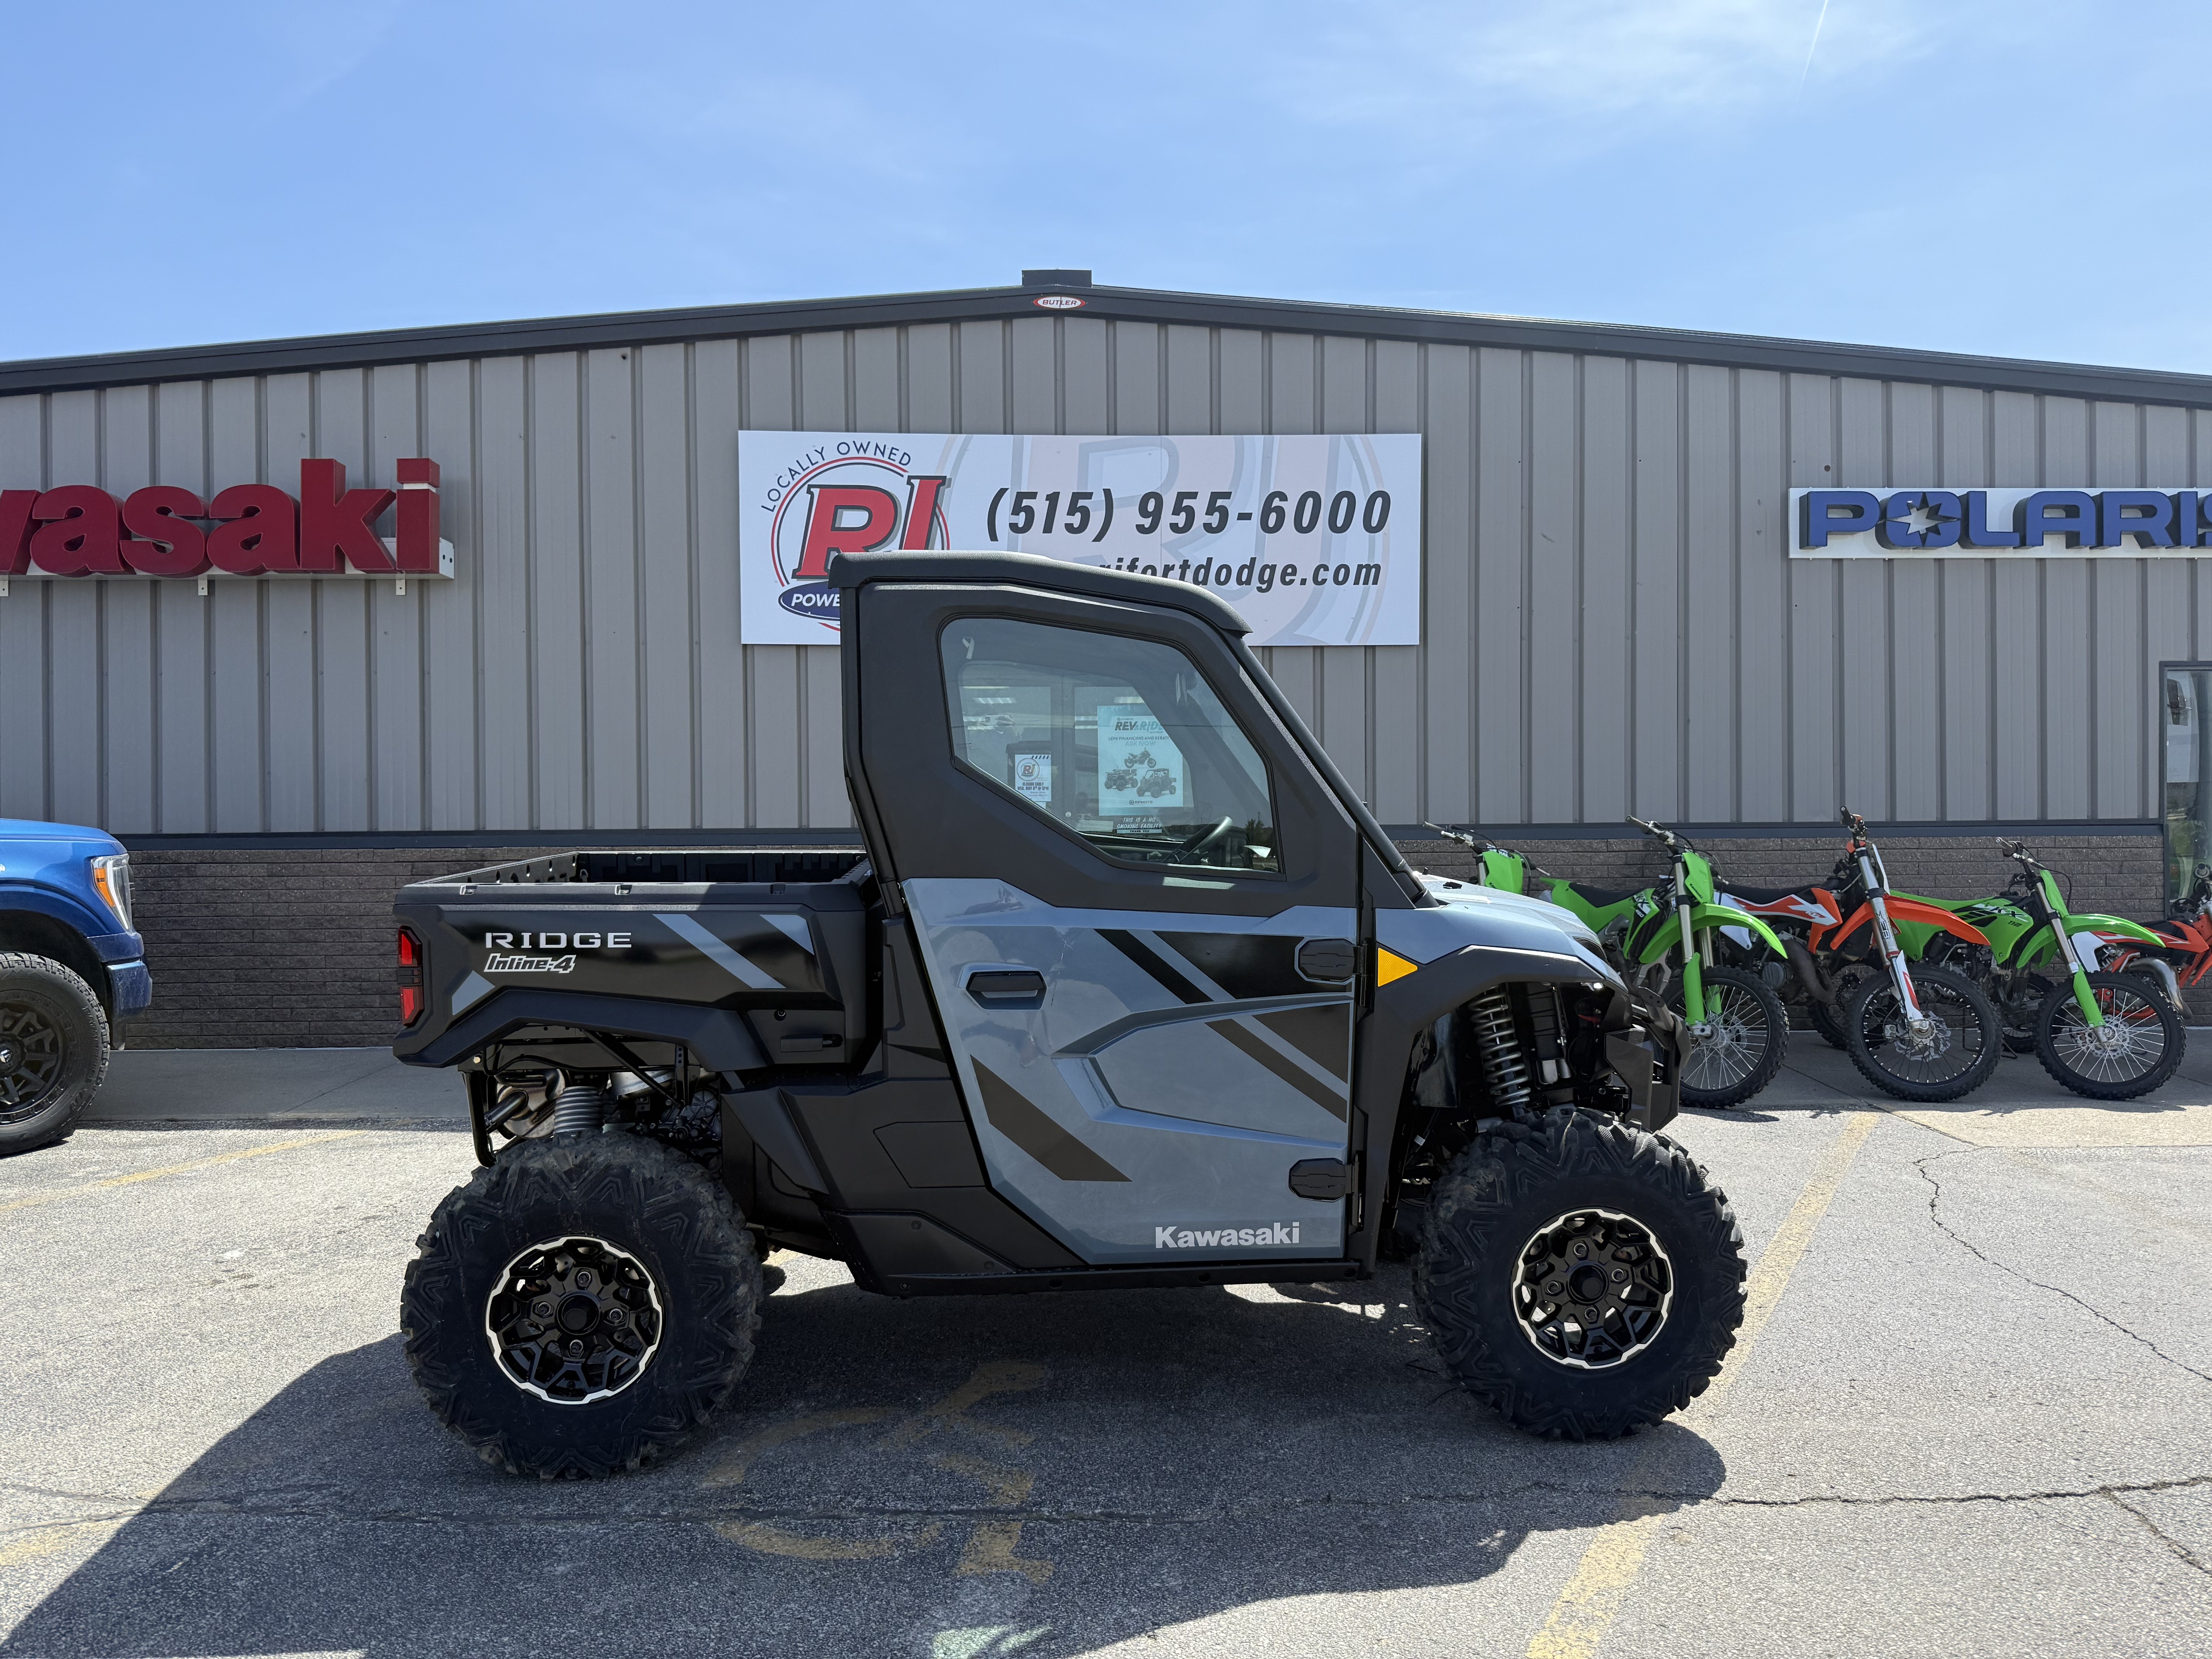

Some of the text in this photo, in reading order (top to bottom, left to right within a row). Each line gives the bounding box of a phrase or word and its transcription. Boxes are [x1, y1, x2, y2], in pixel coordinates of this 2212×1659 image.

[761, 440, 911, 512] LOCALLY OWNED
[791, 475, 953, 580] RI
[988, 488, 1391, 543] (515) 955-6000
[1799, 491, 2212, 550] POLARI
[1633, 892, 1649, 909] KX
[486, 933, 632, 948] RIDGE
[484, 953, 577, 974] Inline-4
[1156, 1222, 1299, 1248] Kawasaki
